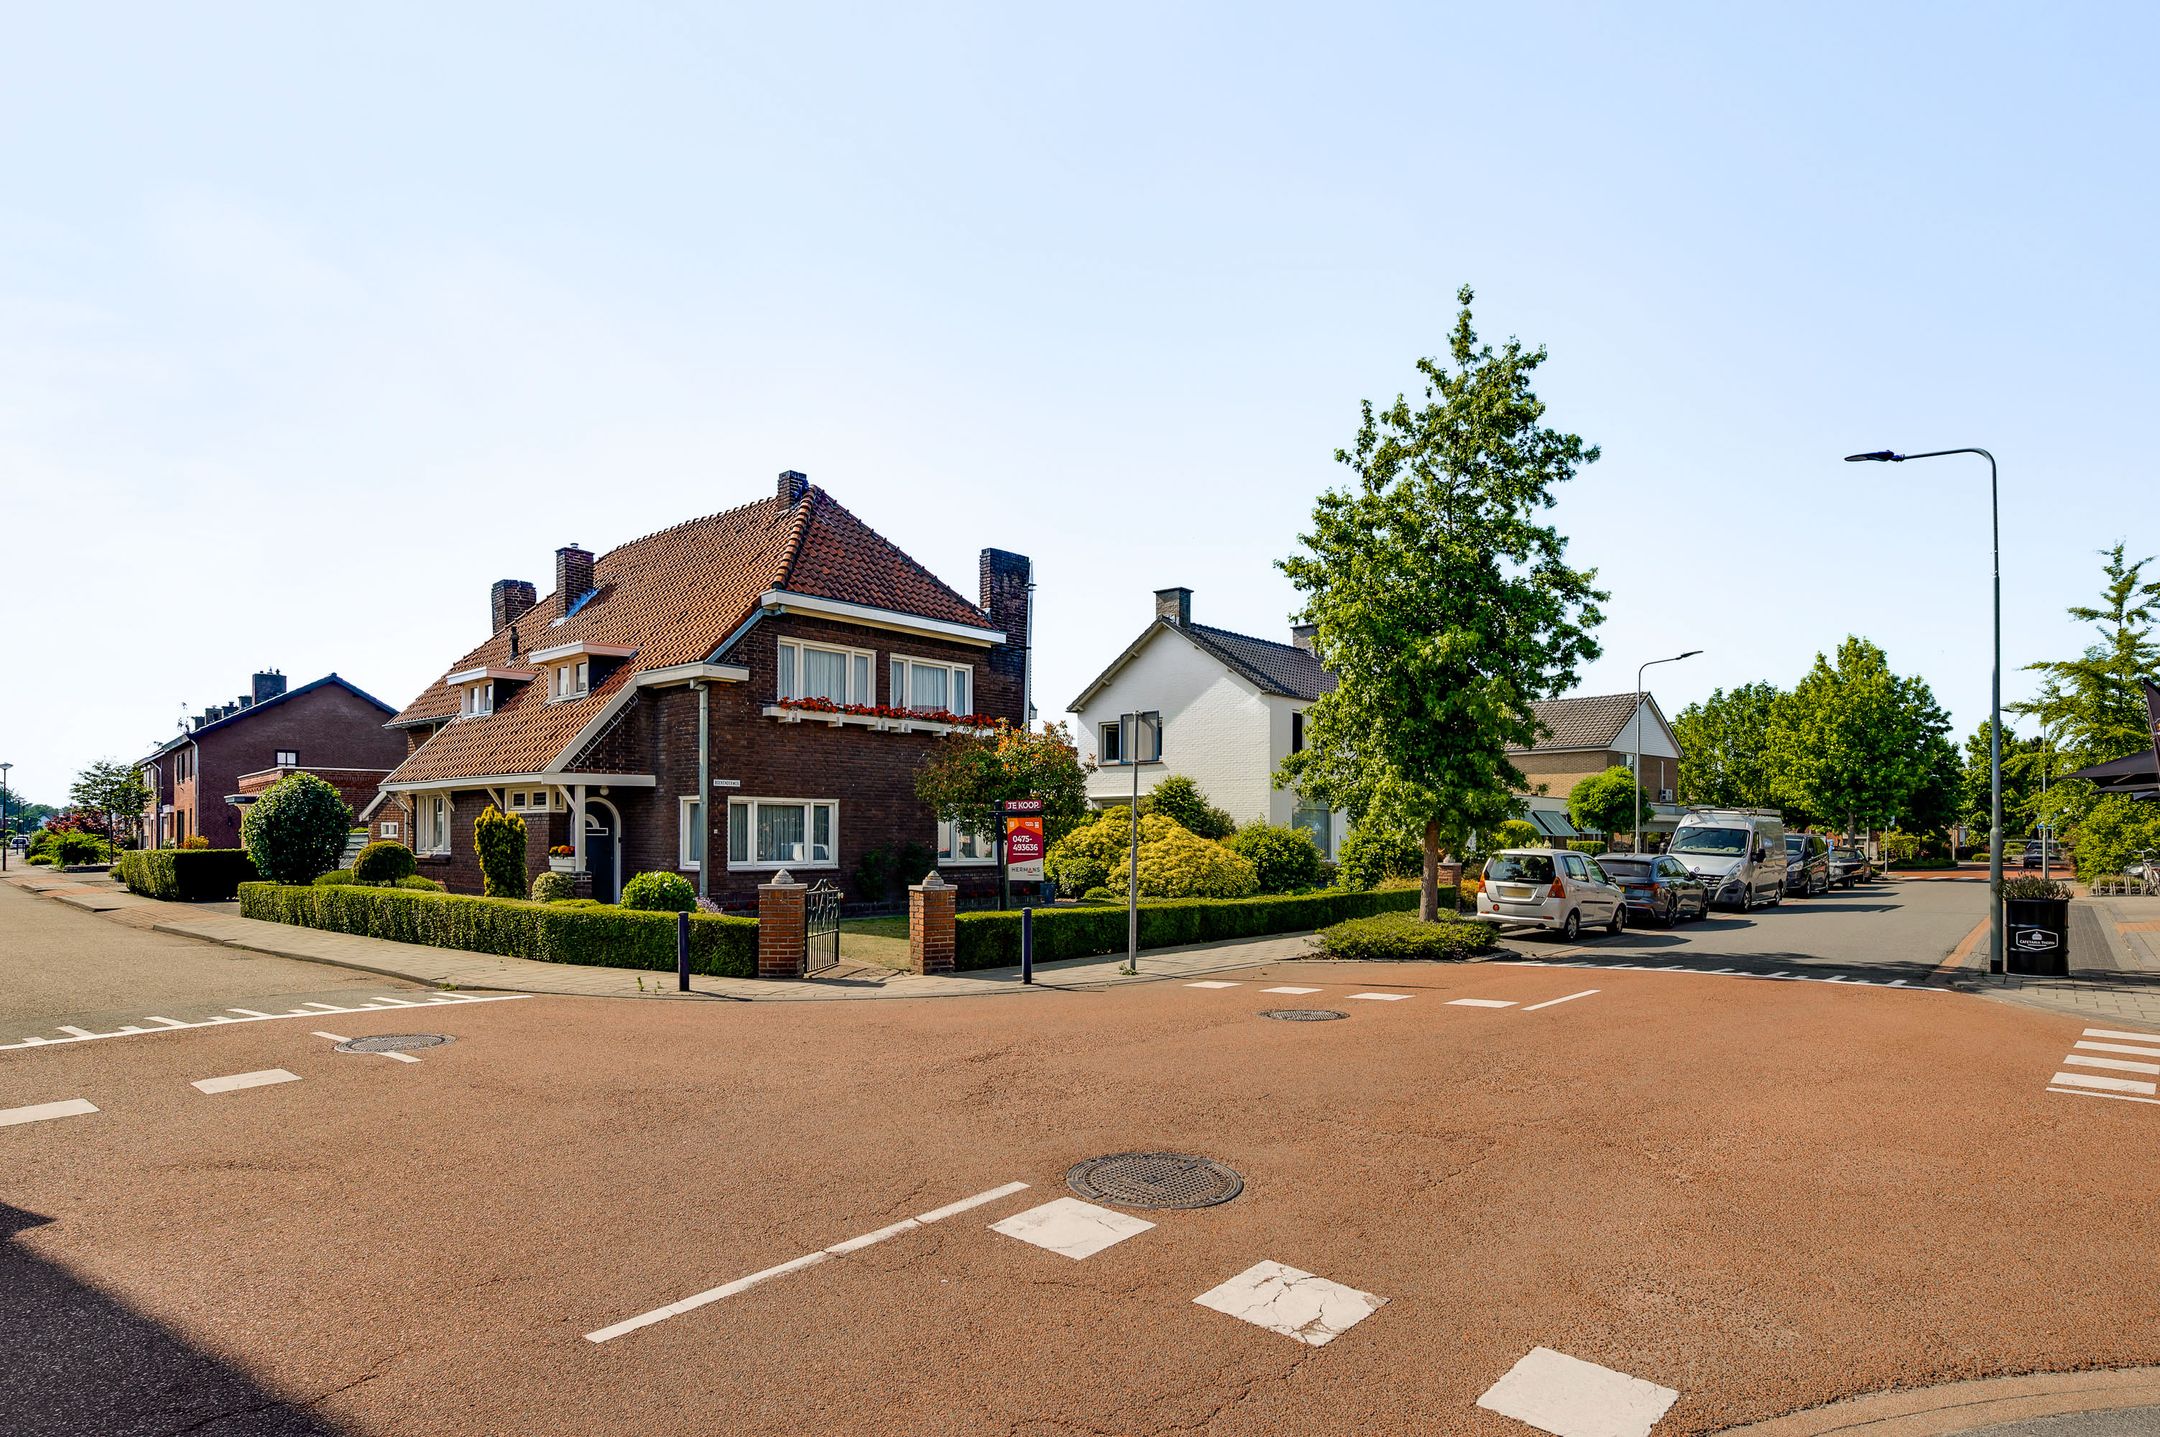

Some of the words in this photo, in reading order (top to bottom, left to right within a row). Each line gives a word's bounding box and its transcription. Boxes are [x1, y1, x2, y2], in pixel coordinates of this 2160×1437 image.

[1018, 801, 1040, 809] KOOP
[1012, 835, 1033, 843] 0475-
[1012, 843, 1038, 851] 493636
